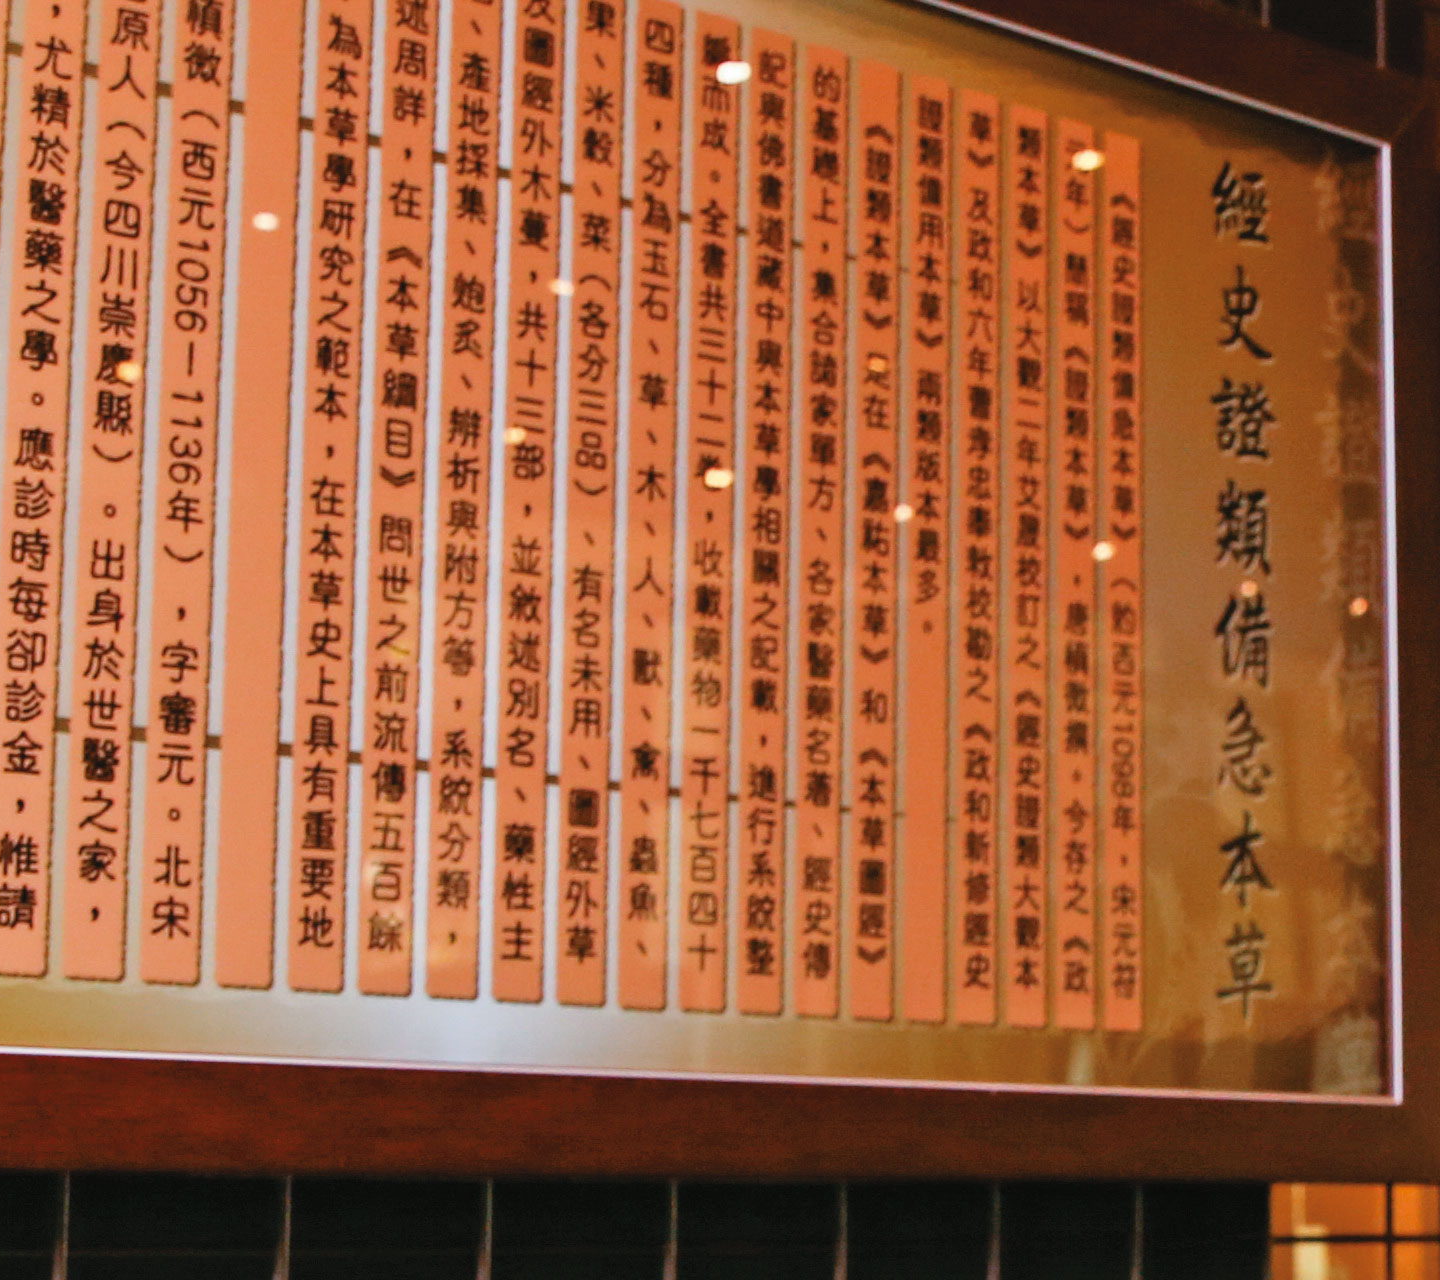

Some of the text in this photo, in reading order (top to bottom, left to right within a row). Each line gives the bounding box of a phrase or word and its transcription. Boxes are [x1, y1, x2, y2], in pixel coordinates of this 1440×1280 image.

[1210, 161, 1277, 1018] 經史證類備急本草
